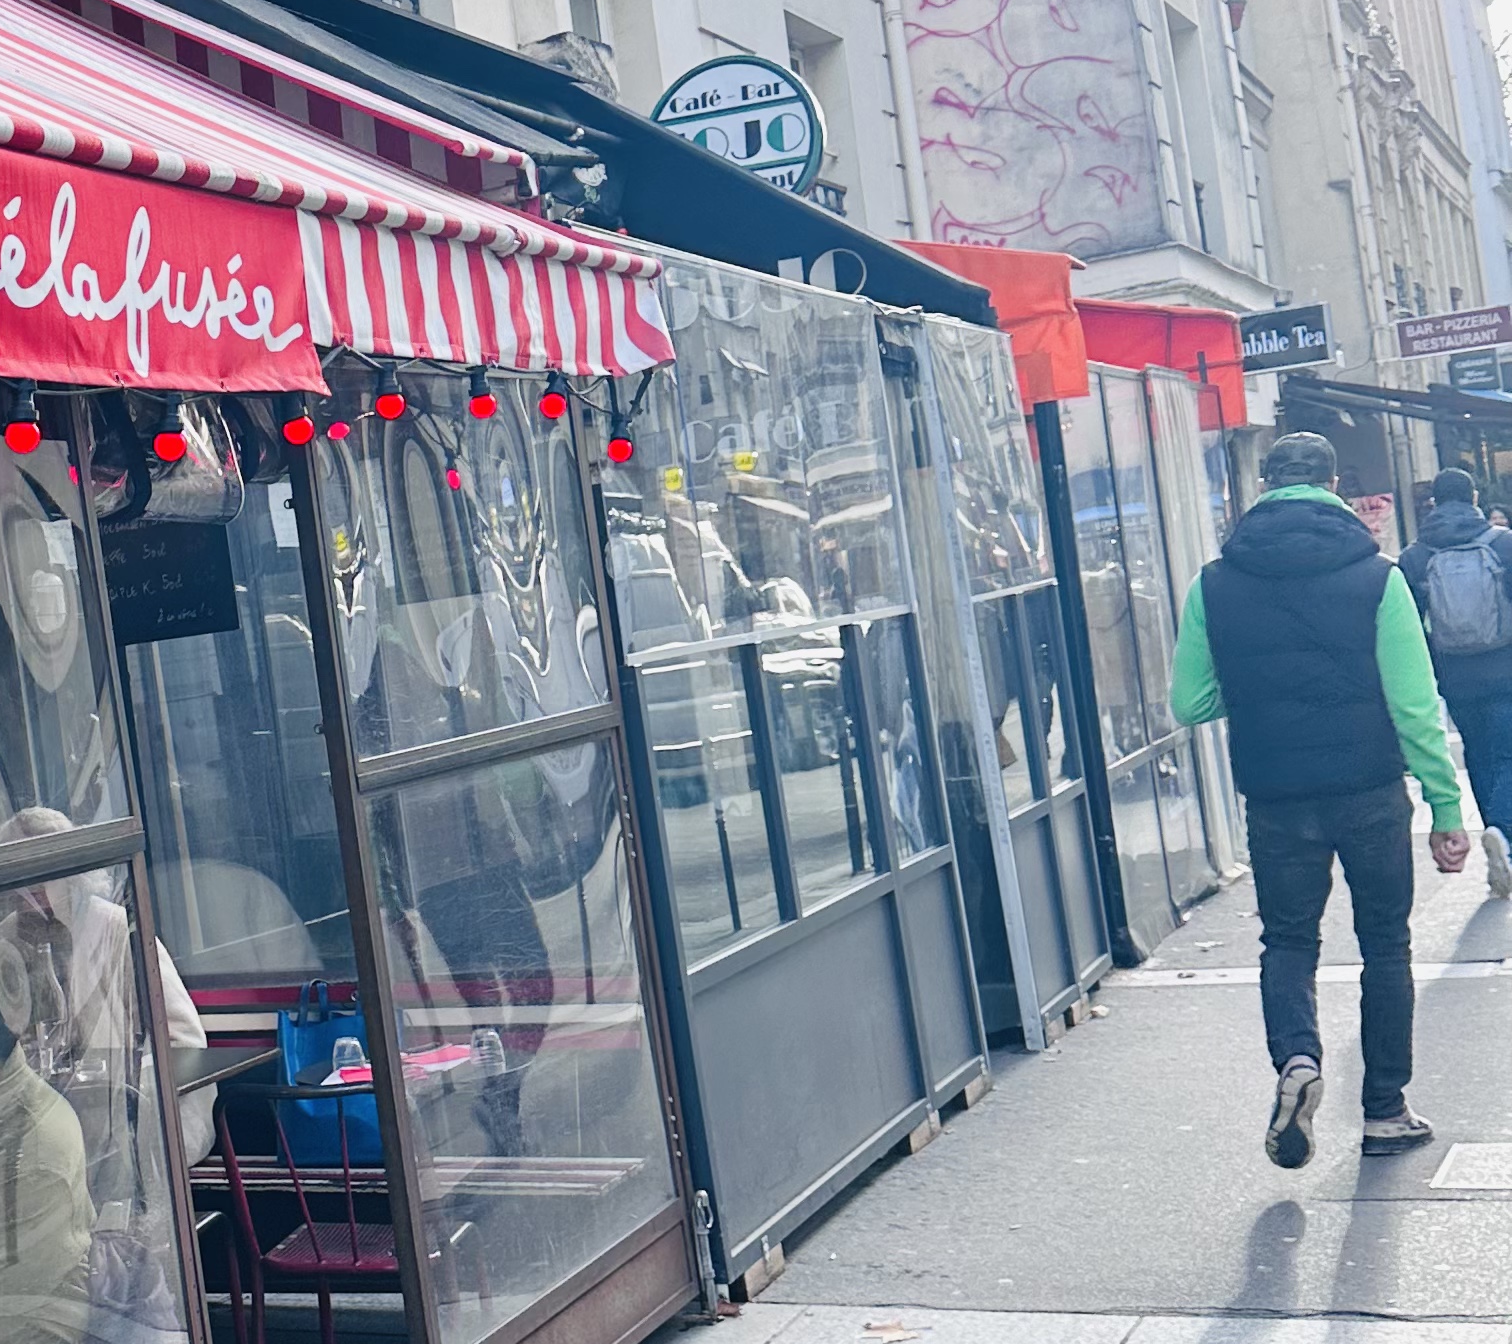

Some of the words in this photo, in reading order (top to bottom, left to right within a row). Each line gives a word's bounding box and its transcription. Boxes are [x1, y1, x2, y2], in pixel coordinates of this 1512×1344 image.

[669, 88, 721, 113] Café
[741, 80, 785, 101] Bar
[678, 112, 806, 160] OJO
[1241, 329, 1290, 357] ubble
[1291, 324, 1325, 349] Tea
[1405, 322, 1435, 338] BAR
[1443, 311, 1503, 332] PIZZERIA
[1412, 327, 1499, 352] RESTAURANT
